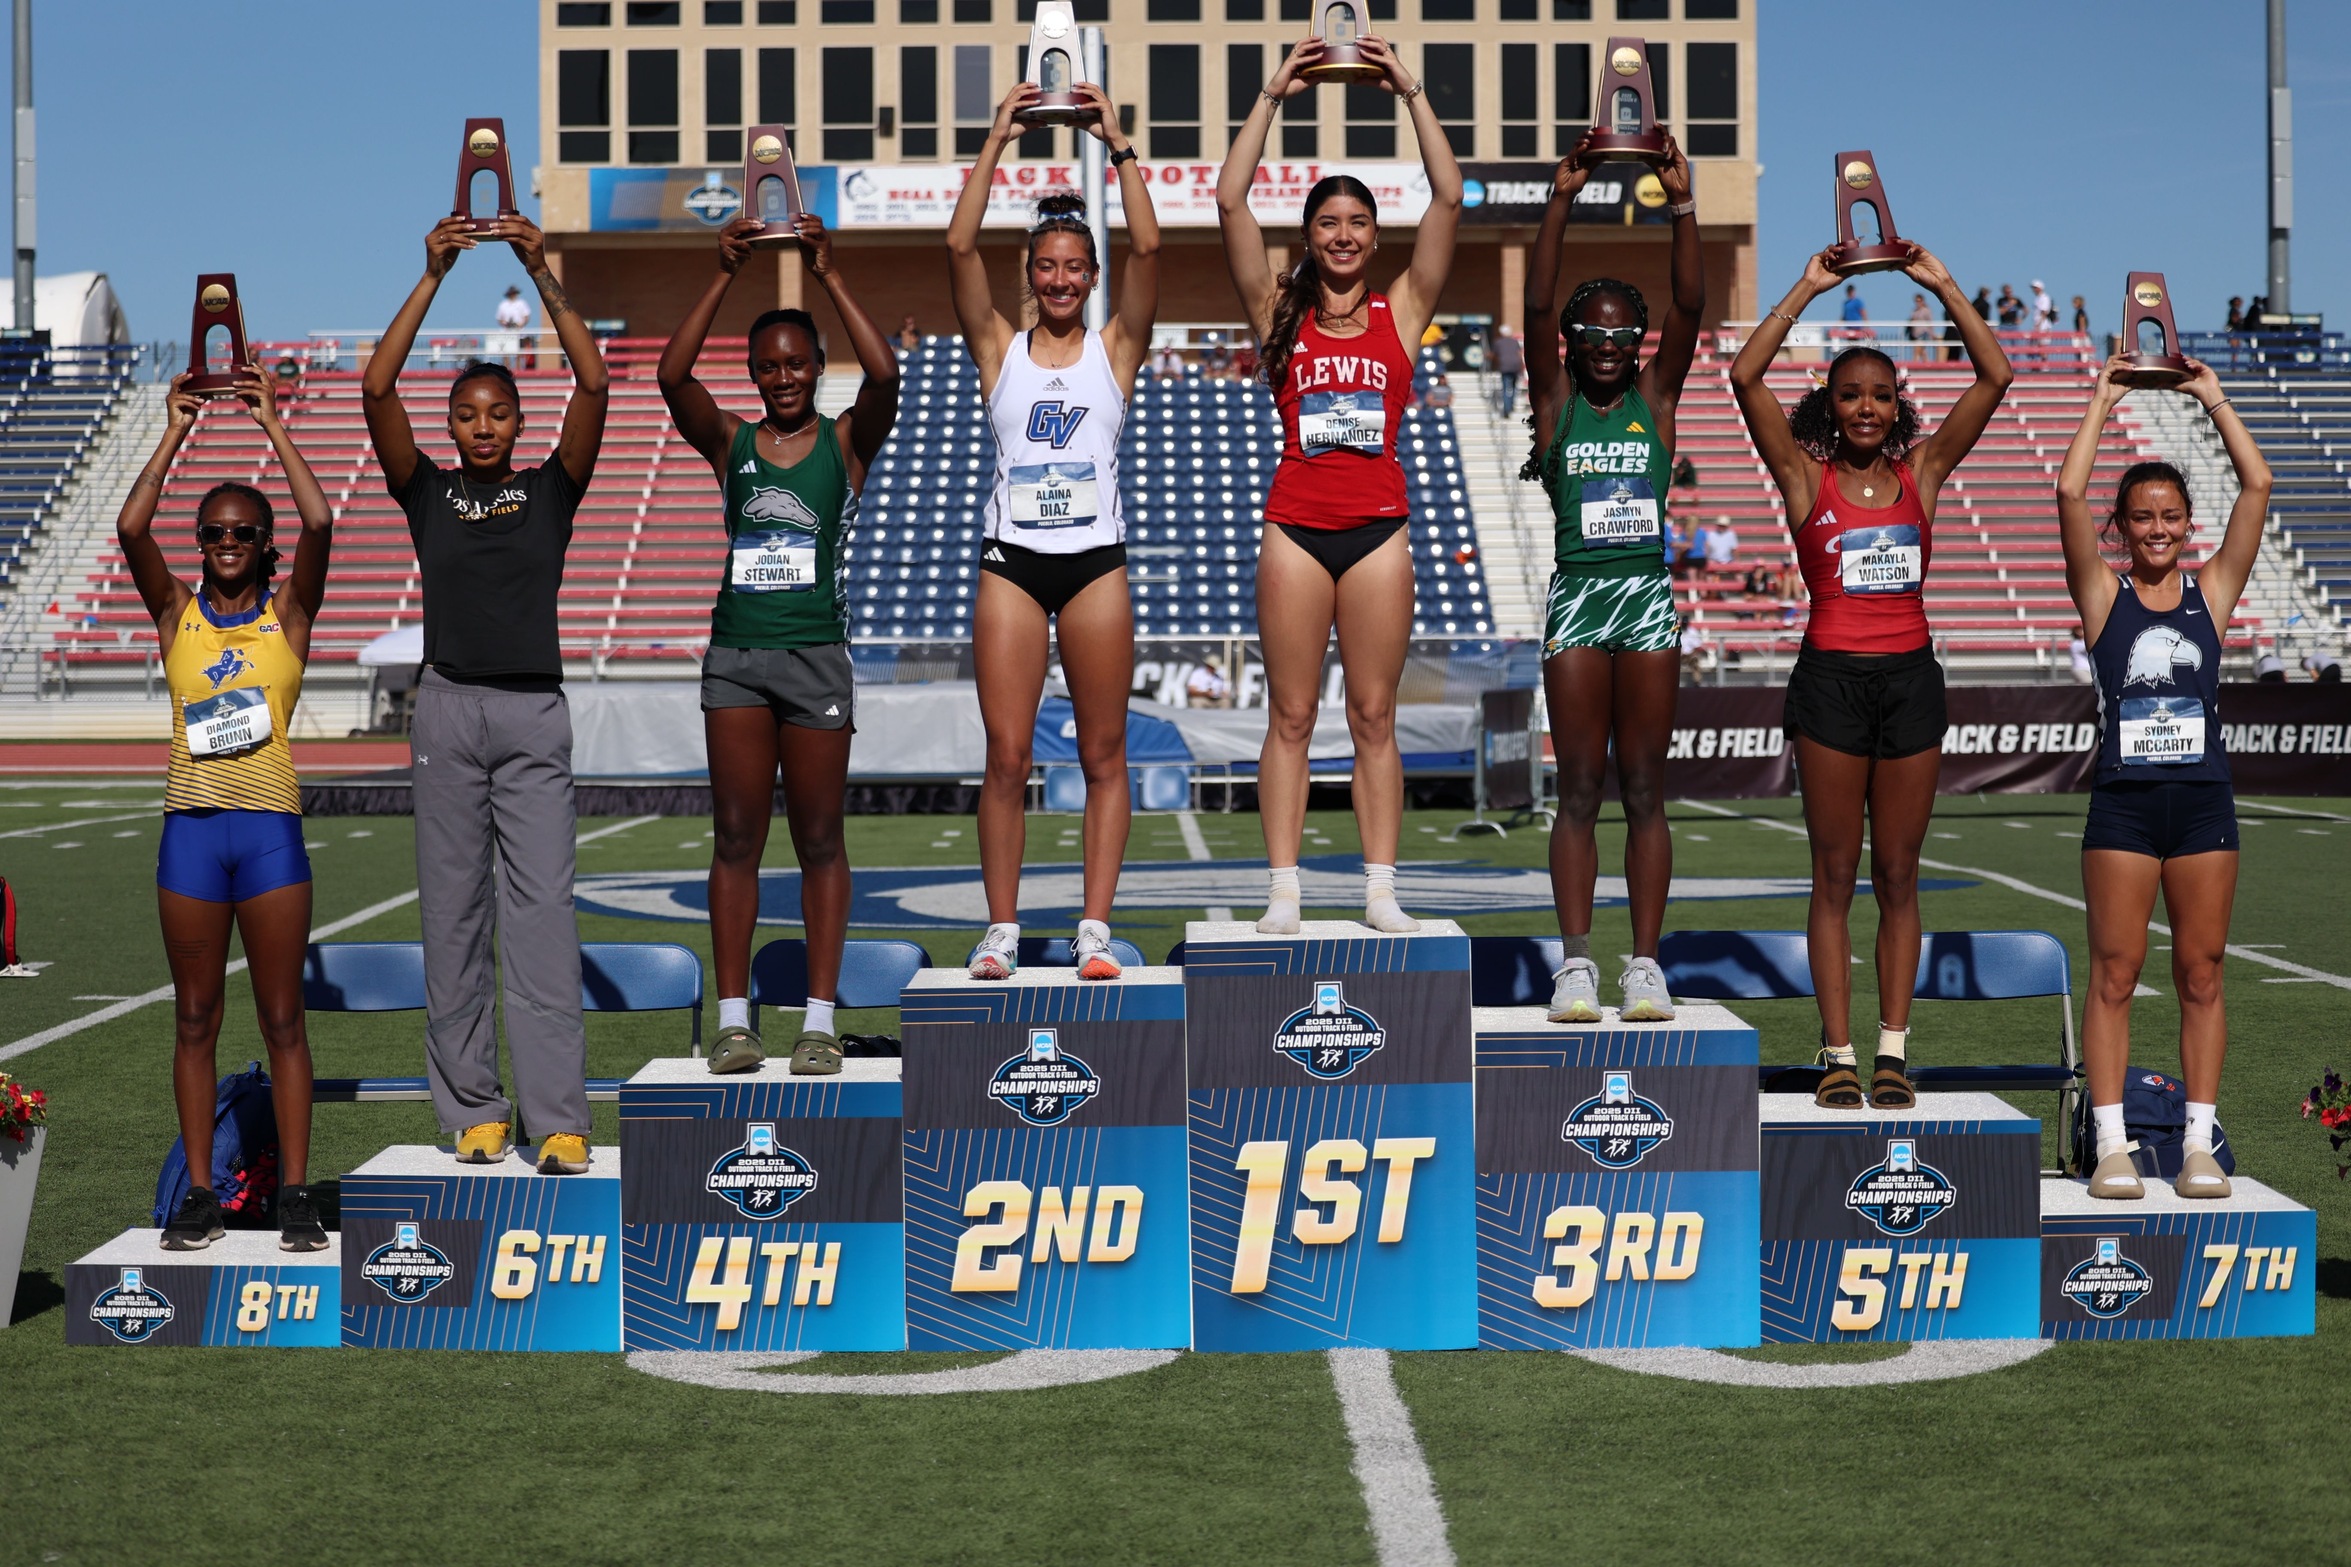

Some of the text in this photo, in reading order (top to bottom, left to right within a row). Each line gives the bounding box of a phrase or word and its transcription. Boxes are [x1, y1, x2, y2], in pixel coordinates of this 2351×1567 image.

[1486, 182, 1549, 205] TRACK
[1295, 356, 1388, 392] LEWIS
[1026, 400, 1090, 450] GV
[1326, 417, 1360, 429] DENISE
[1306, 429, 1379, 446] HERNANDEZ
[1565, 442, 1650, 459] GOLDEN
[1567, 458, 1649, 476] EAGLES
[1036, 489, 1072, 500] ALAINA
[491, 504, 520, 516] FIELD
[1040, 502, 1070, 517] DIAZ
[1603, 506, 1641, 518] JASMYN
[1590, 519, 1653, 535] CRAWFORD
[755, 554, 790, 565] JODIAN
[1862, 553, 1907, 566] MAKAYLA
[744, 568, 801, 581] STEWART
[1858, 566, 1909, 582] WATSON
[259, 622, 281, 633] GAC
[206, 715, 250, 735] DIAMOND
[2144, 725, 2181, 736] SYDNEY
[210, 727, 253, 749] BRUNN
[1697, 728, 1718, 759] &
[1718, 727, 1784, 758] FIELD
[1941, 722, 2097, 755] ACK & FIELD
[2134, 738, 2193, 754] MCCARTY
[2222, 723, 2278, 753] RACK
[2279, 724, 2298, 754] &
[1277, 1033, 1382, 1048] CHAMPIONSHIPS
[992, 1080, 1097, 1094] CHAMPIONSHIPS
[1565, 1123, 1670, 1136] CHAMPIONSHIPS
[710, 1174, 814, 1187] CHAMPIONSHIPS
[1849, 1190, 1953, 1204] CHAMPIONSHIPS
[1230, 1137, 1437, 1294] 1ST
[951, 1180, 1144, 1292] 2ND
[1532, 1205, 1705, 1308] 3RD
[365, 1265, 451, 1276] CHAMPIONSHIPS
[490, 1230, 607, 1300] 6TH
[685, 1237, 842, 1330] 4TH
[2199, 1244, 2298, 1308] 7TH
[1831, 1248, 1970, 1330] 5TH
[2064, 1280, 2150, 1292] CHAMPIONSHIPS
[93, 1307, 172, 1318] CHAMPIONSHIPS
[236, 1281, 320, 1332] 8TH
